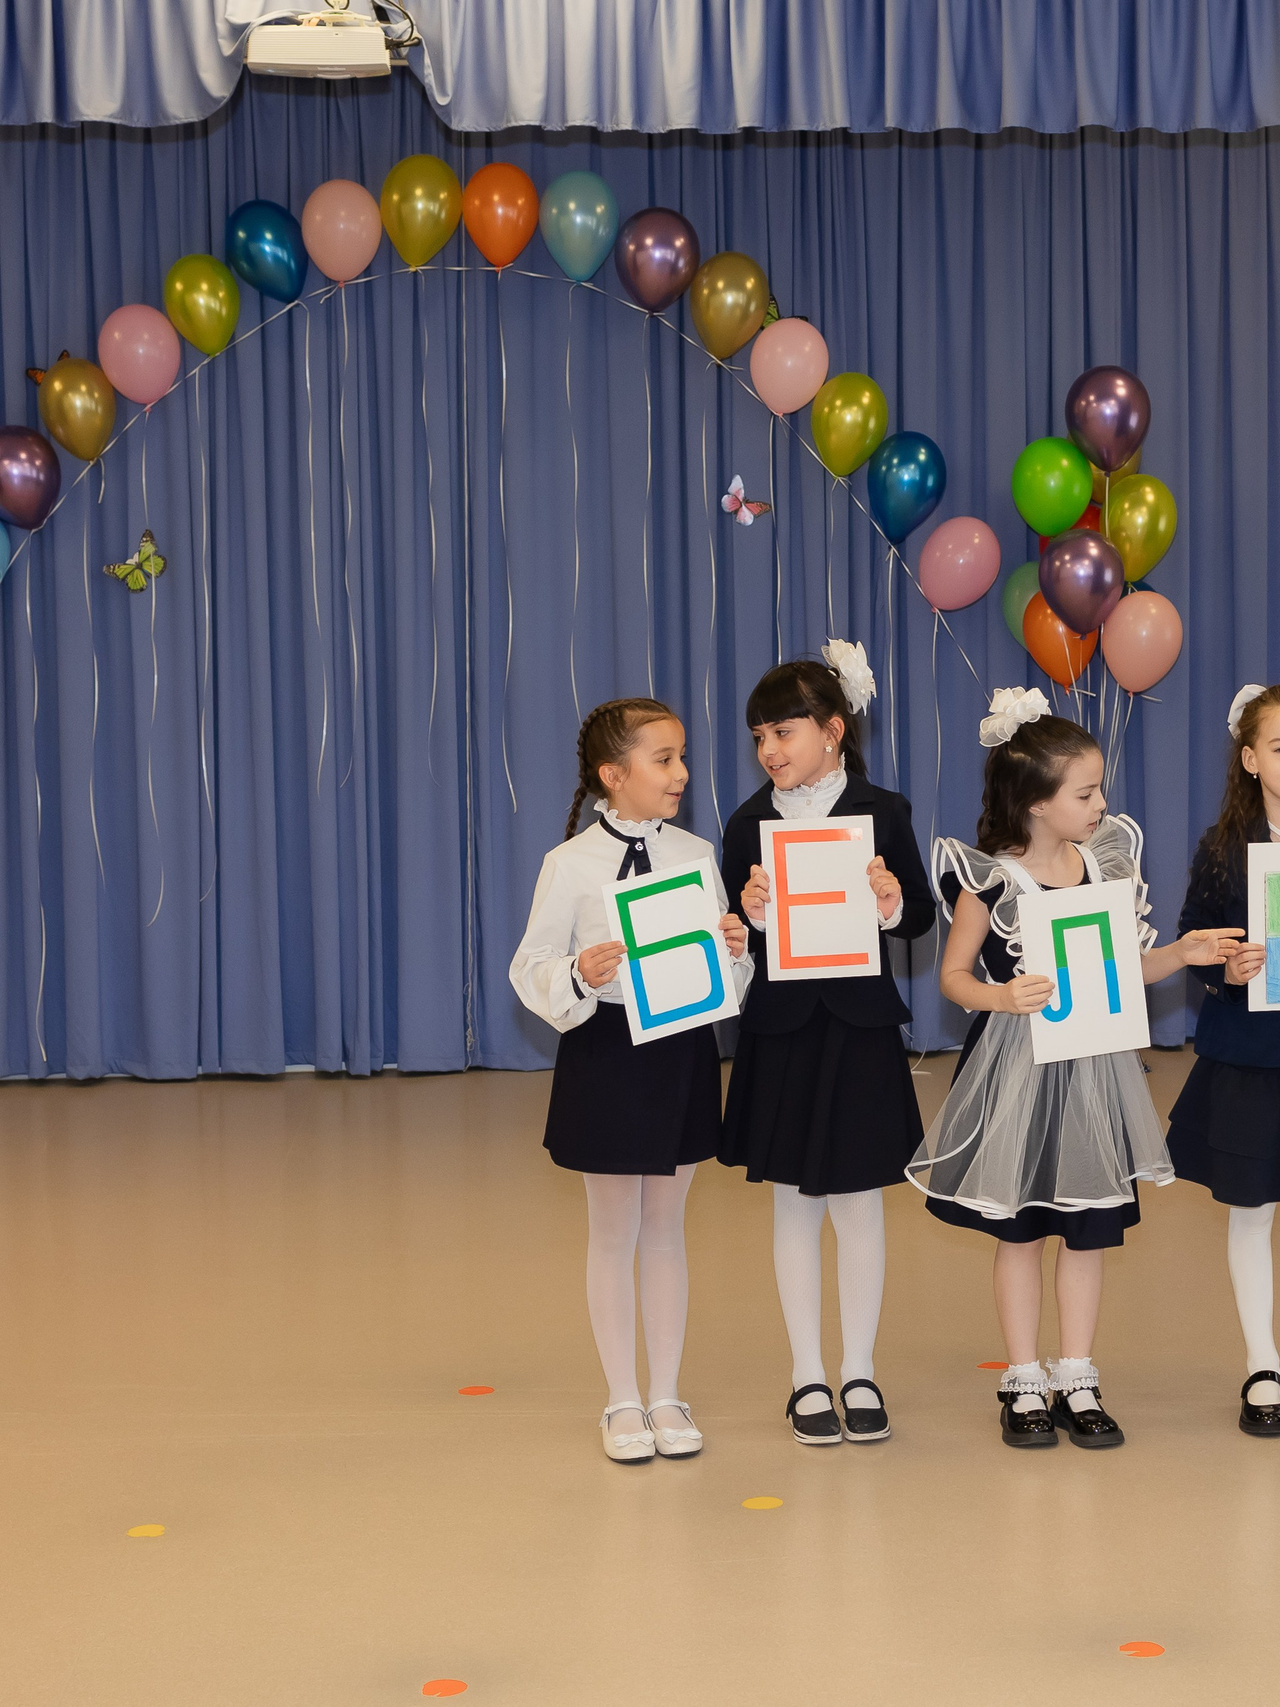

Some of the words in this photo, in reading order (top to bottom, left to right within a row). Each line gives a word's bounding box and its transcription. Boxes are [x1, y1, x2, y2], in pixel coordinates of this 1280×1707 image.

[615, 870, 725, 1031] Б
[772, 828, 869, 970] Е
[1041, 911, 1122, 1023] Л
